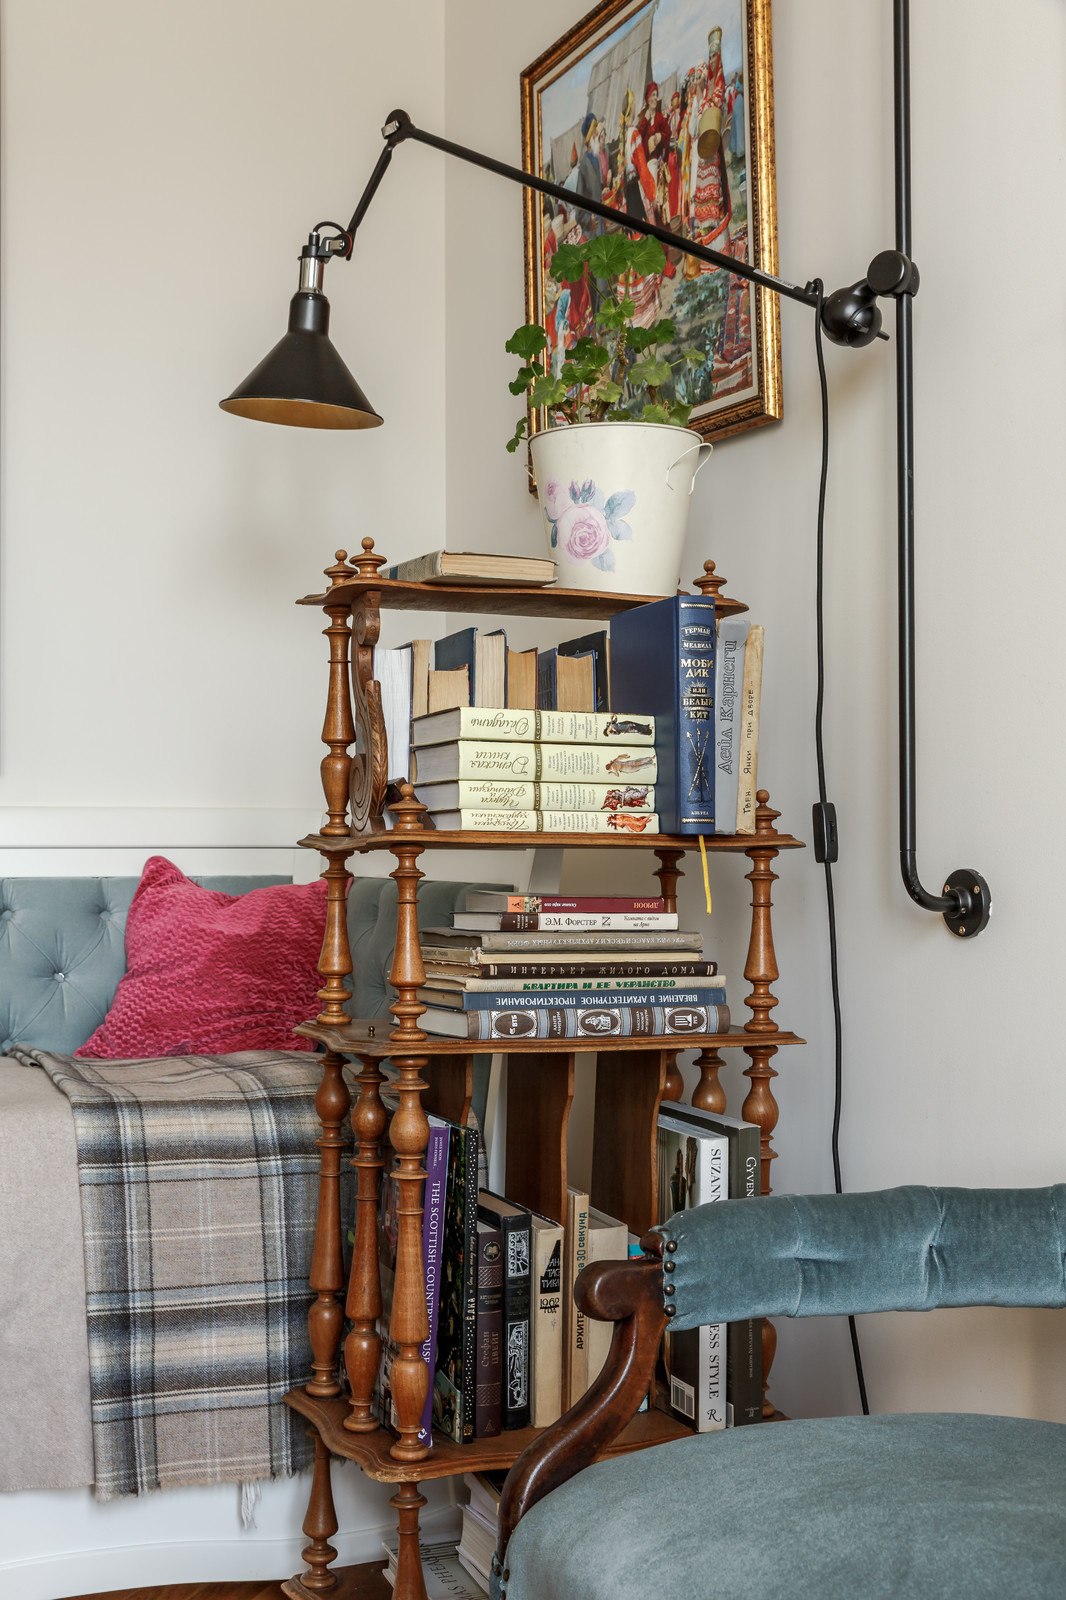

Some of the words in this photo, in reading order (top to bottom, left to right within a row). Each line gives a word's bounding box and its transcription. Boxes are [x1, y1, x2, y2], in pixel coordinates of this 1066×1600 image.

[684, 626, 711, 636] ГЕРМАН
[682, 641, 713, 650] МЕЛВИЛЛ
[680, 658, 714, 669] МОБИ
[720, 640, 738, 722] Карнеги
[682, 697, 713, 707] БЕЛЫЙ
[689, 710, 708, 719] КИТ
[470, 713, 529, 735] Обладать
[475, 751, 511, 761] книга
[718, 727, 734, 775] Дейл
[469, 756, 529, 776] Детская
[744, 749, 752, 774] Янки
[469, 782, 526, 796] Фантазии
[480, 796, 519, 808] Чудеса
[474, 819, 529, 831] Призраки
[634, 901, 659, 909] ДРЮОН
[545, 917, 563, 926] Э.М.
[507, 939, 530, 947] ФОРМ
[532, 938, 594, 947] АРХИТЕКТУРНЫХ
[595, 937, 655, 945] КЛАССИЧЕСКИХ
[510, 967, 586, 976] ИНТЕРЬЕР
[599, 966, 651, 975] ЖИЛОГО
[661, 965, 696, 975] ДОМА
[522, 981, 578, 990] КВАРТИРА
[582, 981, 592, 990] И
[596, 980, 611, 990] ЕЕ
[616, 979, 677, 989] УБРАНСТВО
[495, 997, 576, 1007] ПРОЕКТИРОВАНИЕ
[581, 996, 648, 1005] АРХИТЕКТУРНОЕ
[658, 994, 699, 1003] ВВЕДЕНИЕ
[710, 1148, 722, 1205] SUZANN
[746, 1156, 757, 1198] GYVEN
[431, 1181, 442, 1204] THE
[427, 1206, 440, 1264] SCOTTISH
[578, 1211, 588, 1248] секунд
[577, 1248, 586, 1262] 30
[541, 1280, 560, 1288] ТИКА
[540, 1297, 560, 1308] 1962
[709, 1323, 720, 1349] ESS
[421, 1326, 432, 1363] OUSE
[478, 1331, 490, 1367] Стефан
[708, 1355, 720, 1400] STYLE
[706, 1408, 723, 1423] R
